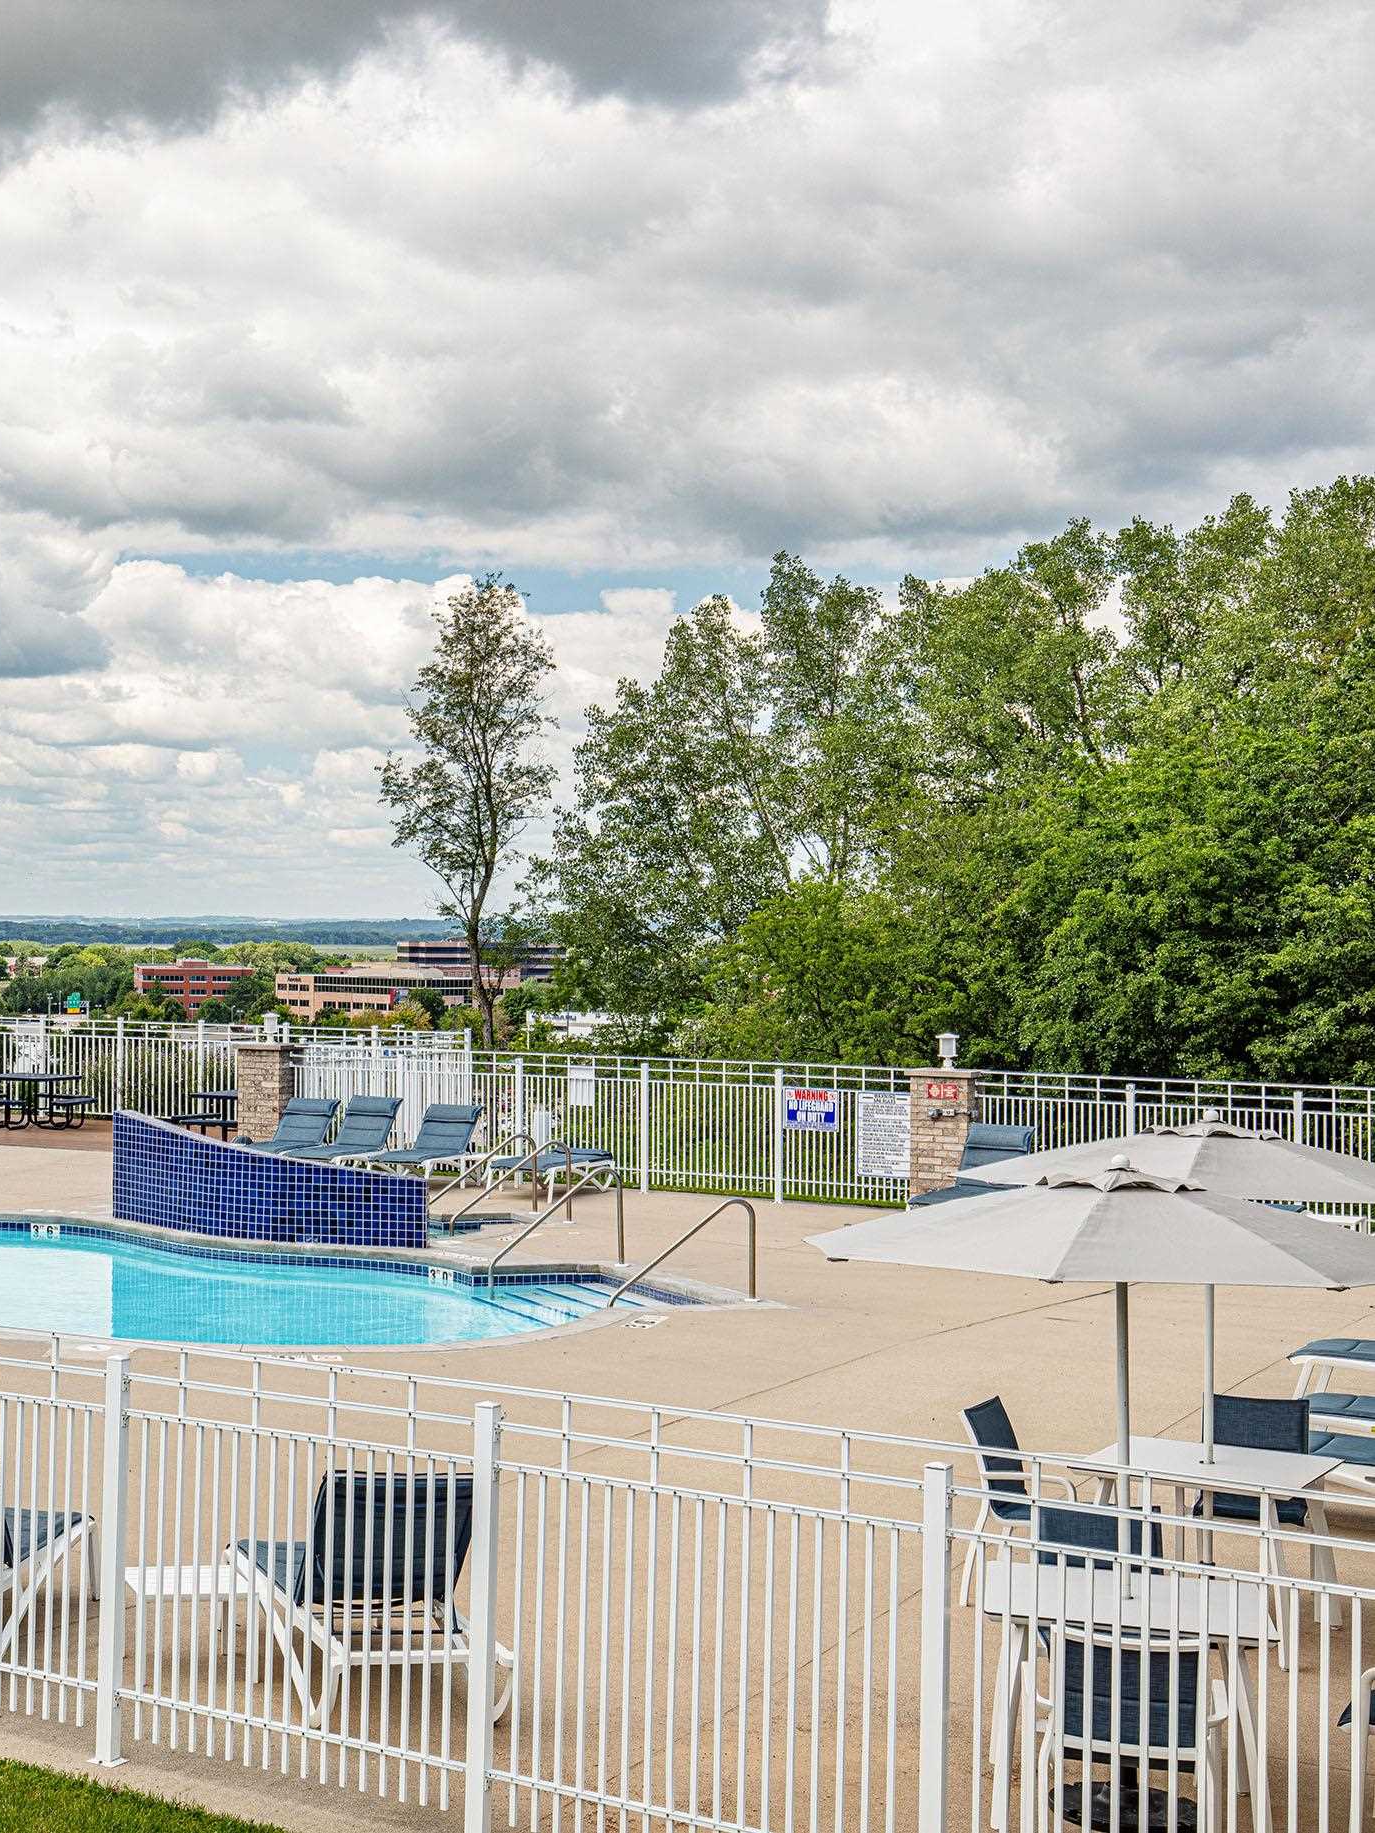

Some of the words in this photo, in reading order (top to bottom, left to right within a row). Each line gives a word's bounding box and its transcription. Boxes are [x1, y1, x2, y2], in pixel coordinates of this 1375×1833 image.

[795, 1089, 828, 1101] WARNING
[789, 1100, 798, 1110] NO
[799, 1101, 833, 1112] LIFEGUARD
[796, 1111, 806, 1122] ON
[807, 1111, 825, 1122] DUTY
[32, 1225, 39, 1234] 3
[46, 1226, 54, 1235] 6
[430, 1269, 436, 1279] 3
